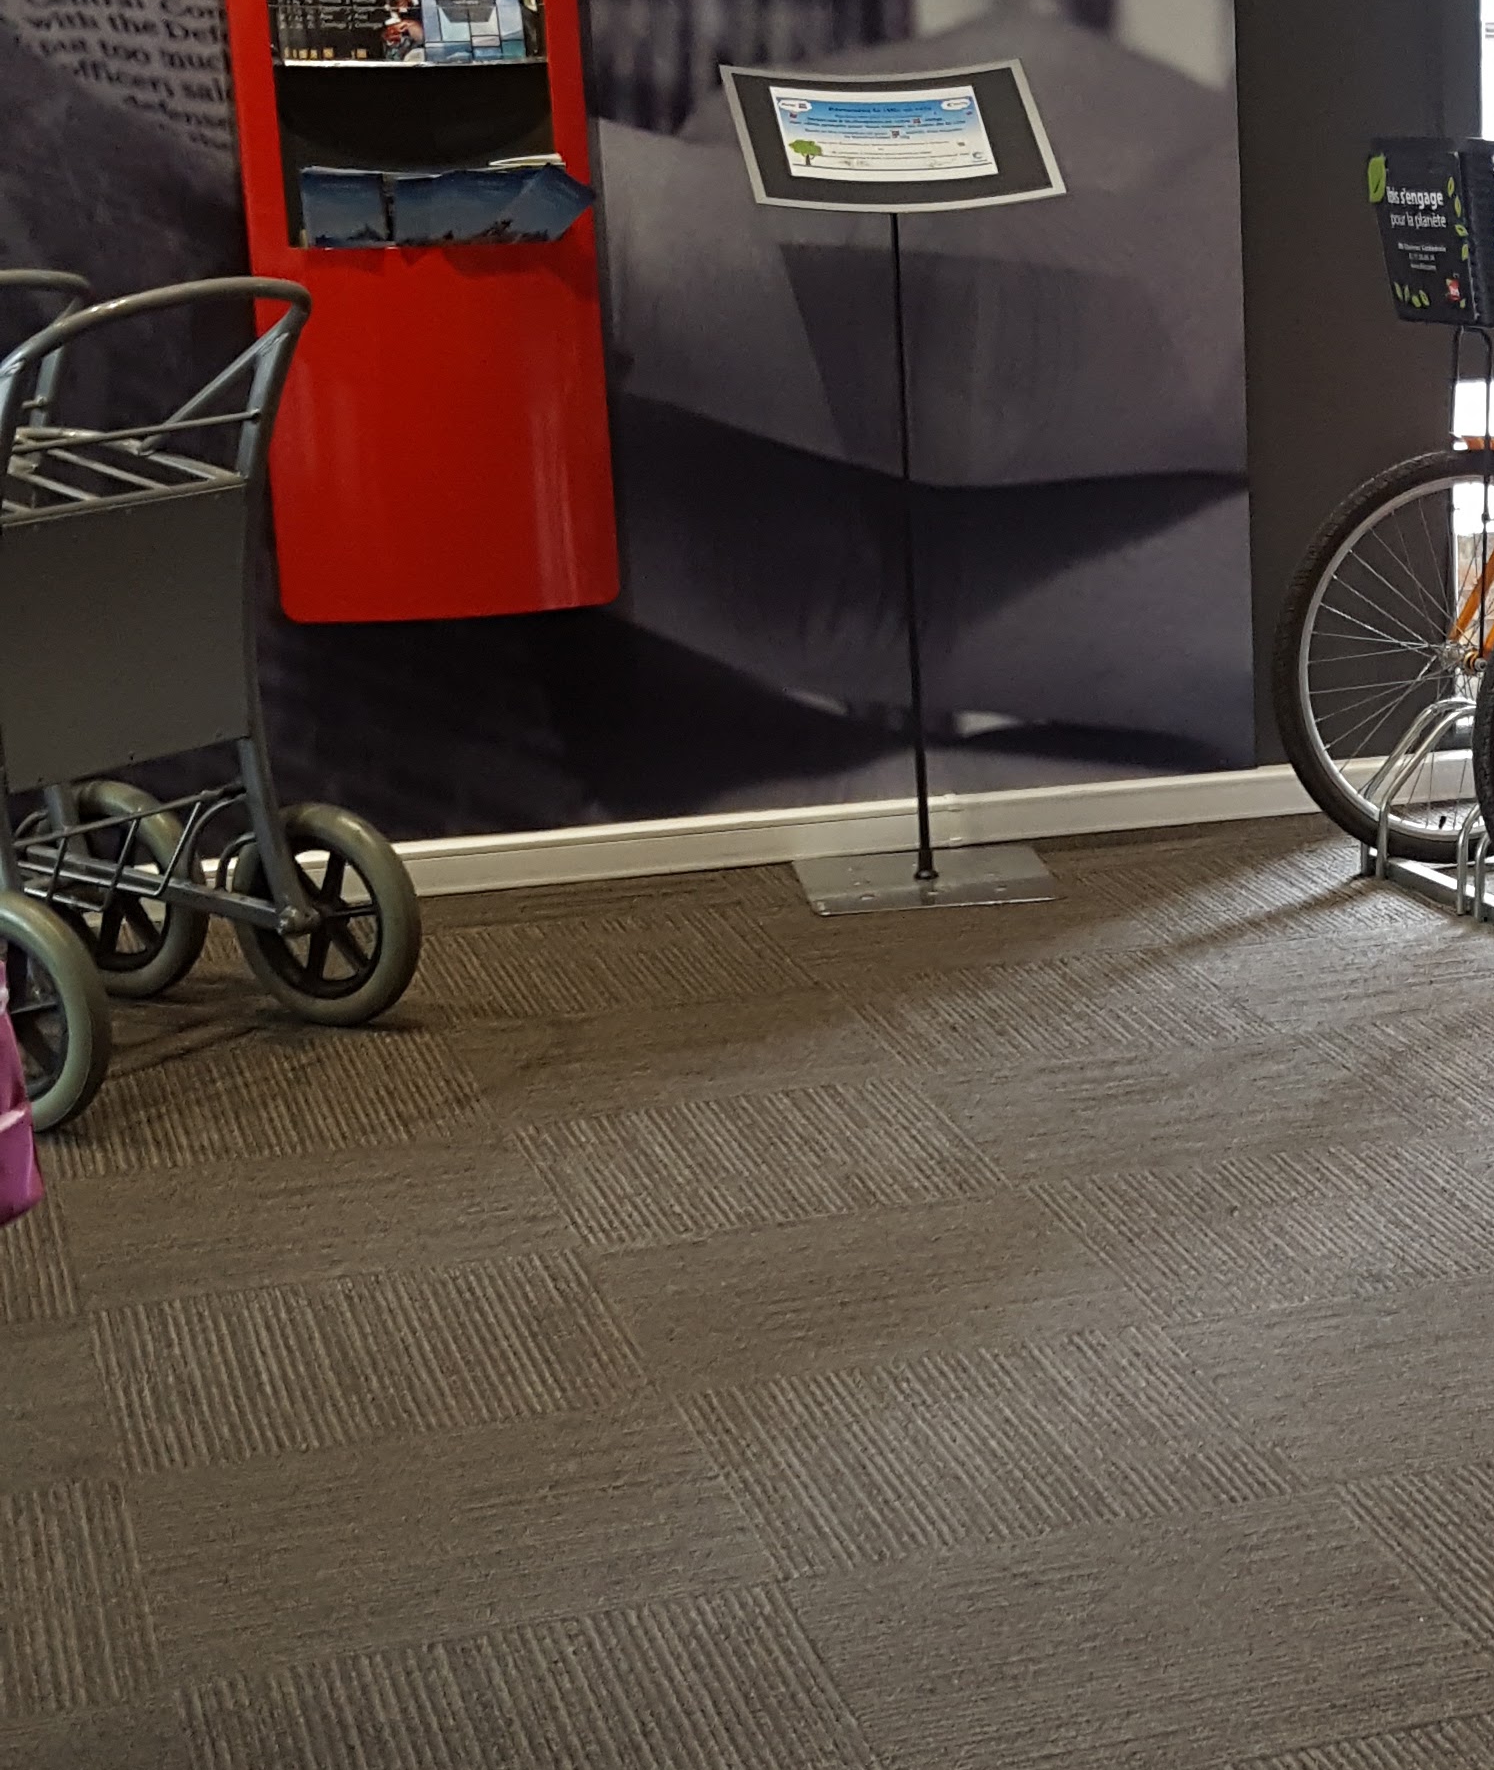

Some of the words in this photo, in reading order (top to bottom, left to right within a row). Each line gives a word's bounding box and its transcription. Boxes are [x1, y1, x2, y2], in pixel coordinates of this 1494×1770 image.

[1386, 186, 1400, 205] ibis
[1400, 187, 1444, 210] s'engage
[1390, 212, 1406, 228] pour
[1406, 211, 1414, 227] la
[1414, 211, 1447, 229] planète
